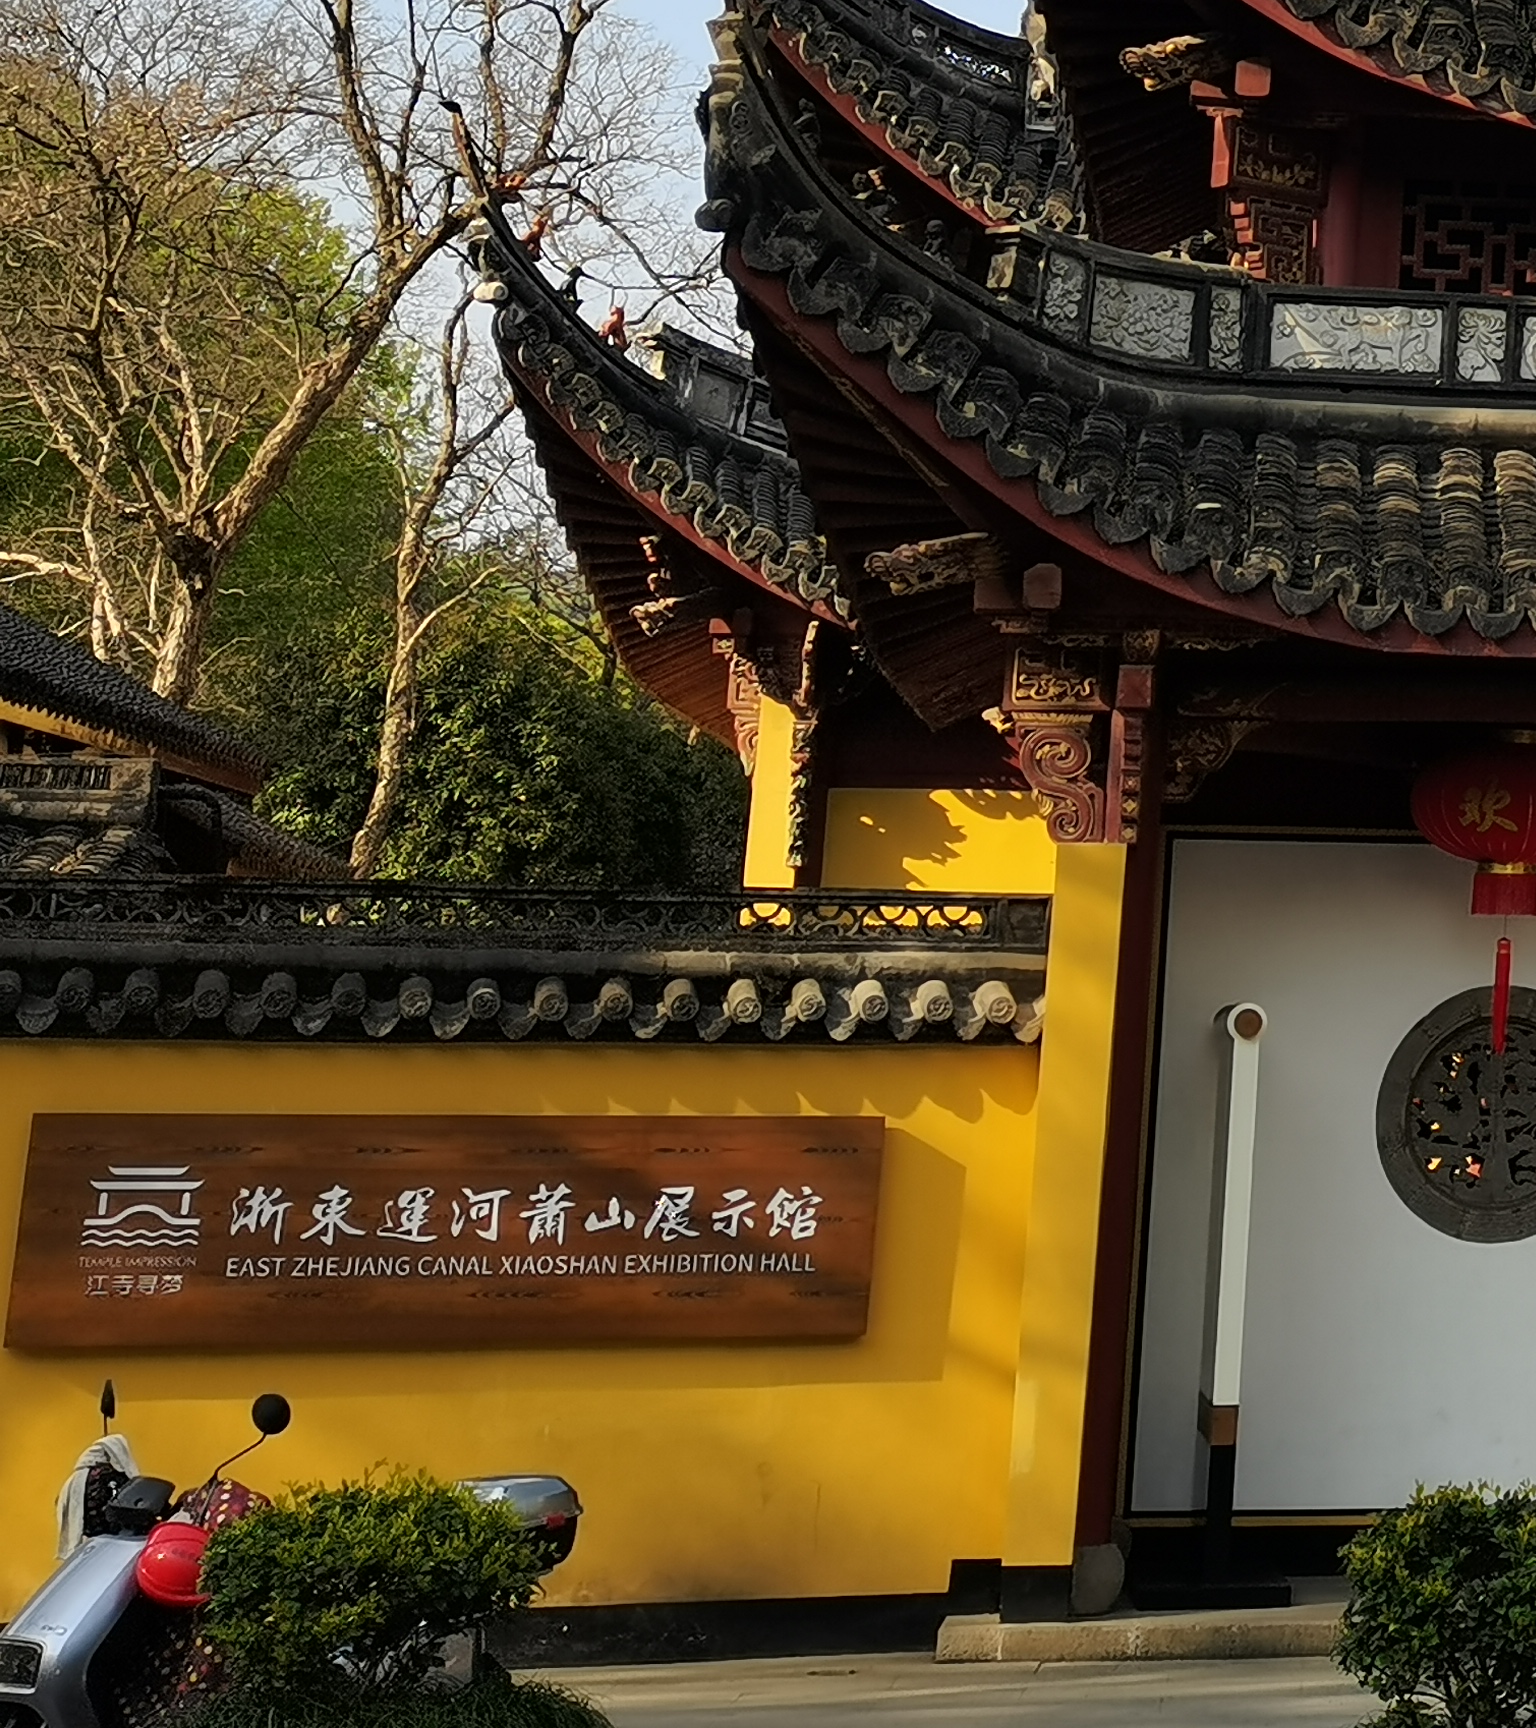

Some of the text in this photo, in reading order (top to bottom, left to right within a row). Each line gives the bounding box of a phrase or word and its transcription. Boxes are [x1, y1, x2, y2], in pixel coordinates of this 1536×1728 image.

[79, 1256, 197, 1268] TEMPLE IMPRESSION
[226, 1252, 816, 1277] EAST ZHEJIANG CANAL XIAOSHAN EXHIBITION HALL
